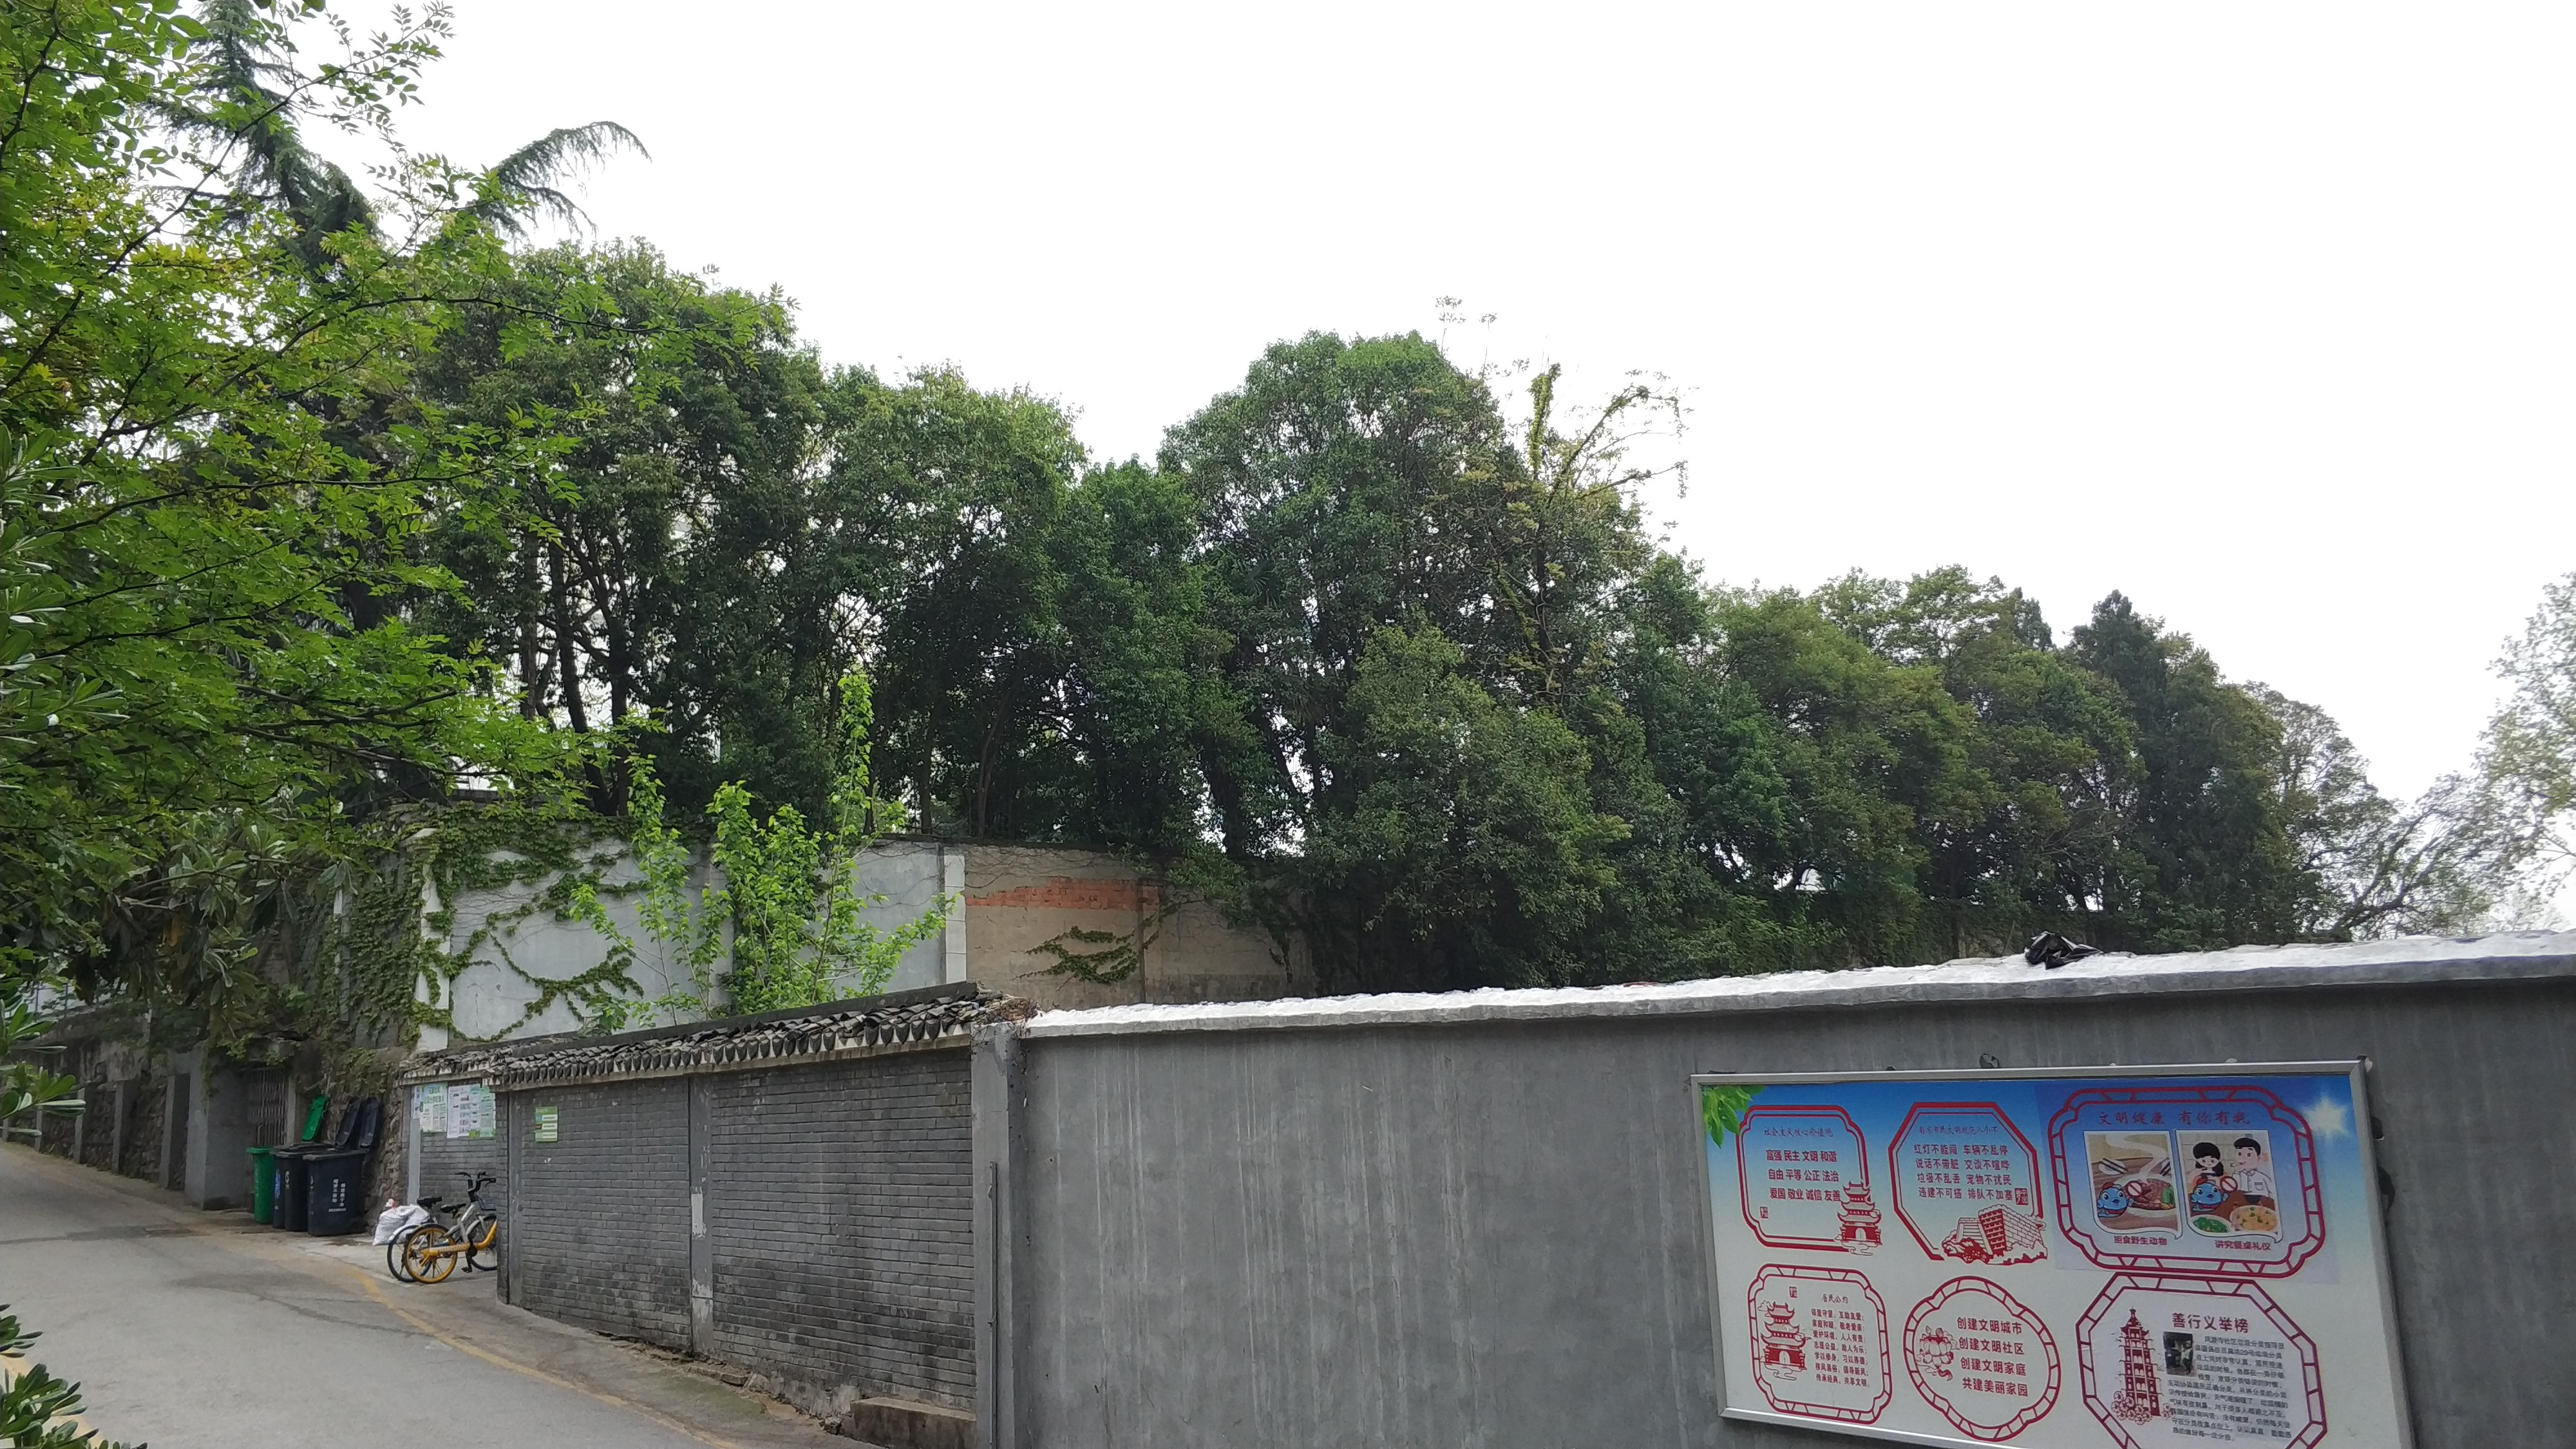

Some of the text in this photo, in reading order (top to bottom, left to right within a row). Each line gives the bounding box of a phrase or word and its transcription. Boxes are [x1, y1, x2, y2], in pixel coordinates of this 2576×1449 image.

[2099, 1111, 2250, 1124] 文明健康 有你有我
[1765, 1127, 1833, 1137] 社会主义核心价值观
[1766, 1150, 1837, 1162] 富强 民主 文明 和谐
[1914, 1144, 2007, 1155] 红灯不能闯 车辆不乱停
[1916, 1158, 2009, 1170] 说话不带脏 交谈不喧哗
[1768, 1169, 1839, 1182] 自由 平等 公正 法治
[1917, 1173, 2011, 1185] 垃圾不乱丢 宠物不扰民
[1770, 1188, 1841, 1201] 爱国 敬业 诚信 友善
[1918, 1187, 1962, 1198] 违建不可搭
[1967, 1188, 2012, 1200] 排队不加塞
[2114, 1235, 2168, 1245] 拒食野生动物
[2215, 1240, 2271, 1251] 讲究餐桌礼仪
[1822, 1294, 1848, 1303] 居民公约
[1957, 1317, 2022, 1334] 创建文明城市
[2172, 1312, 2248, 1333] 善行义举榜
[1959, 1336, 2024, 1355] 创建文明社区
[1960, 1356, 2026, 1376] 创建文明家庭
[1962, 1377, 2028, 1397] 共建美丽家园
